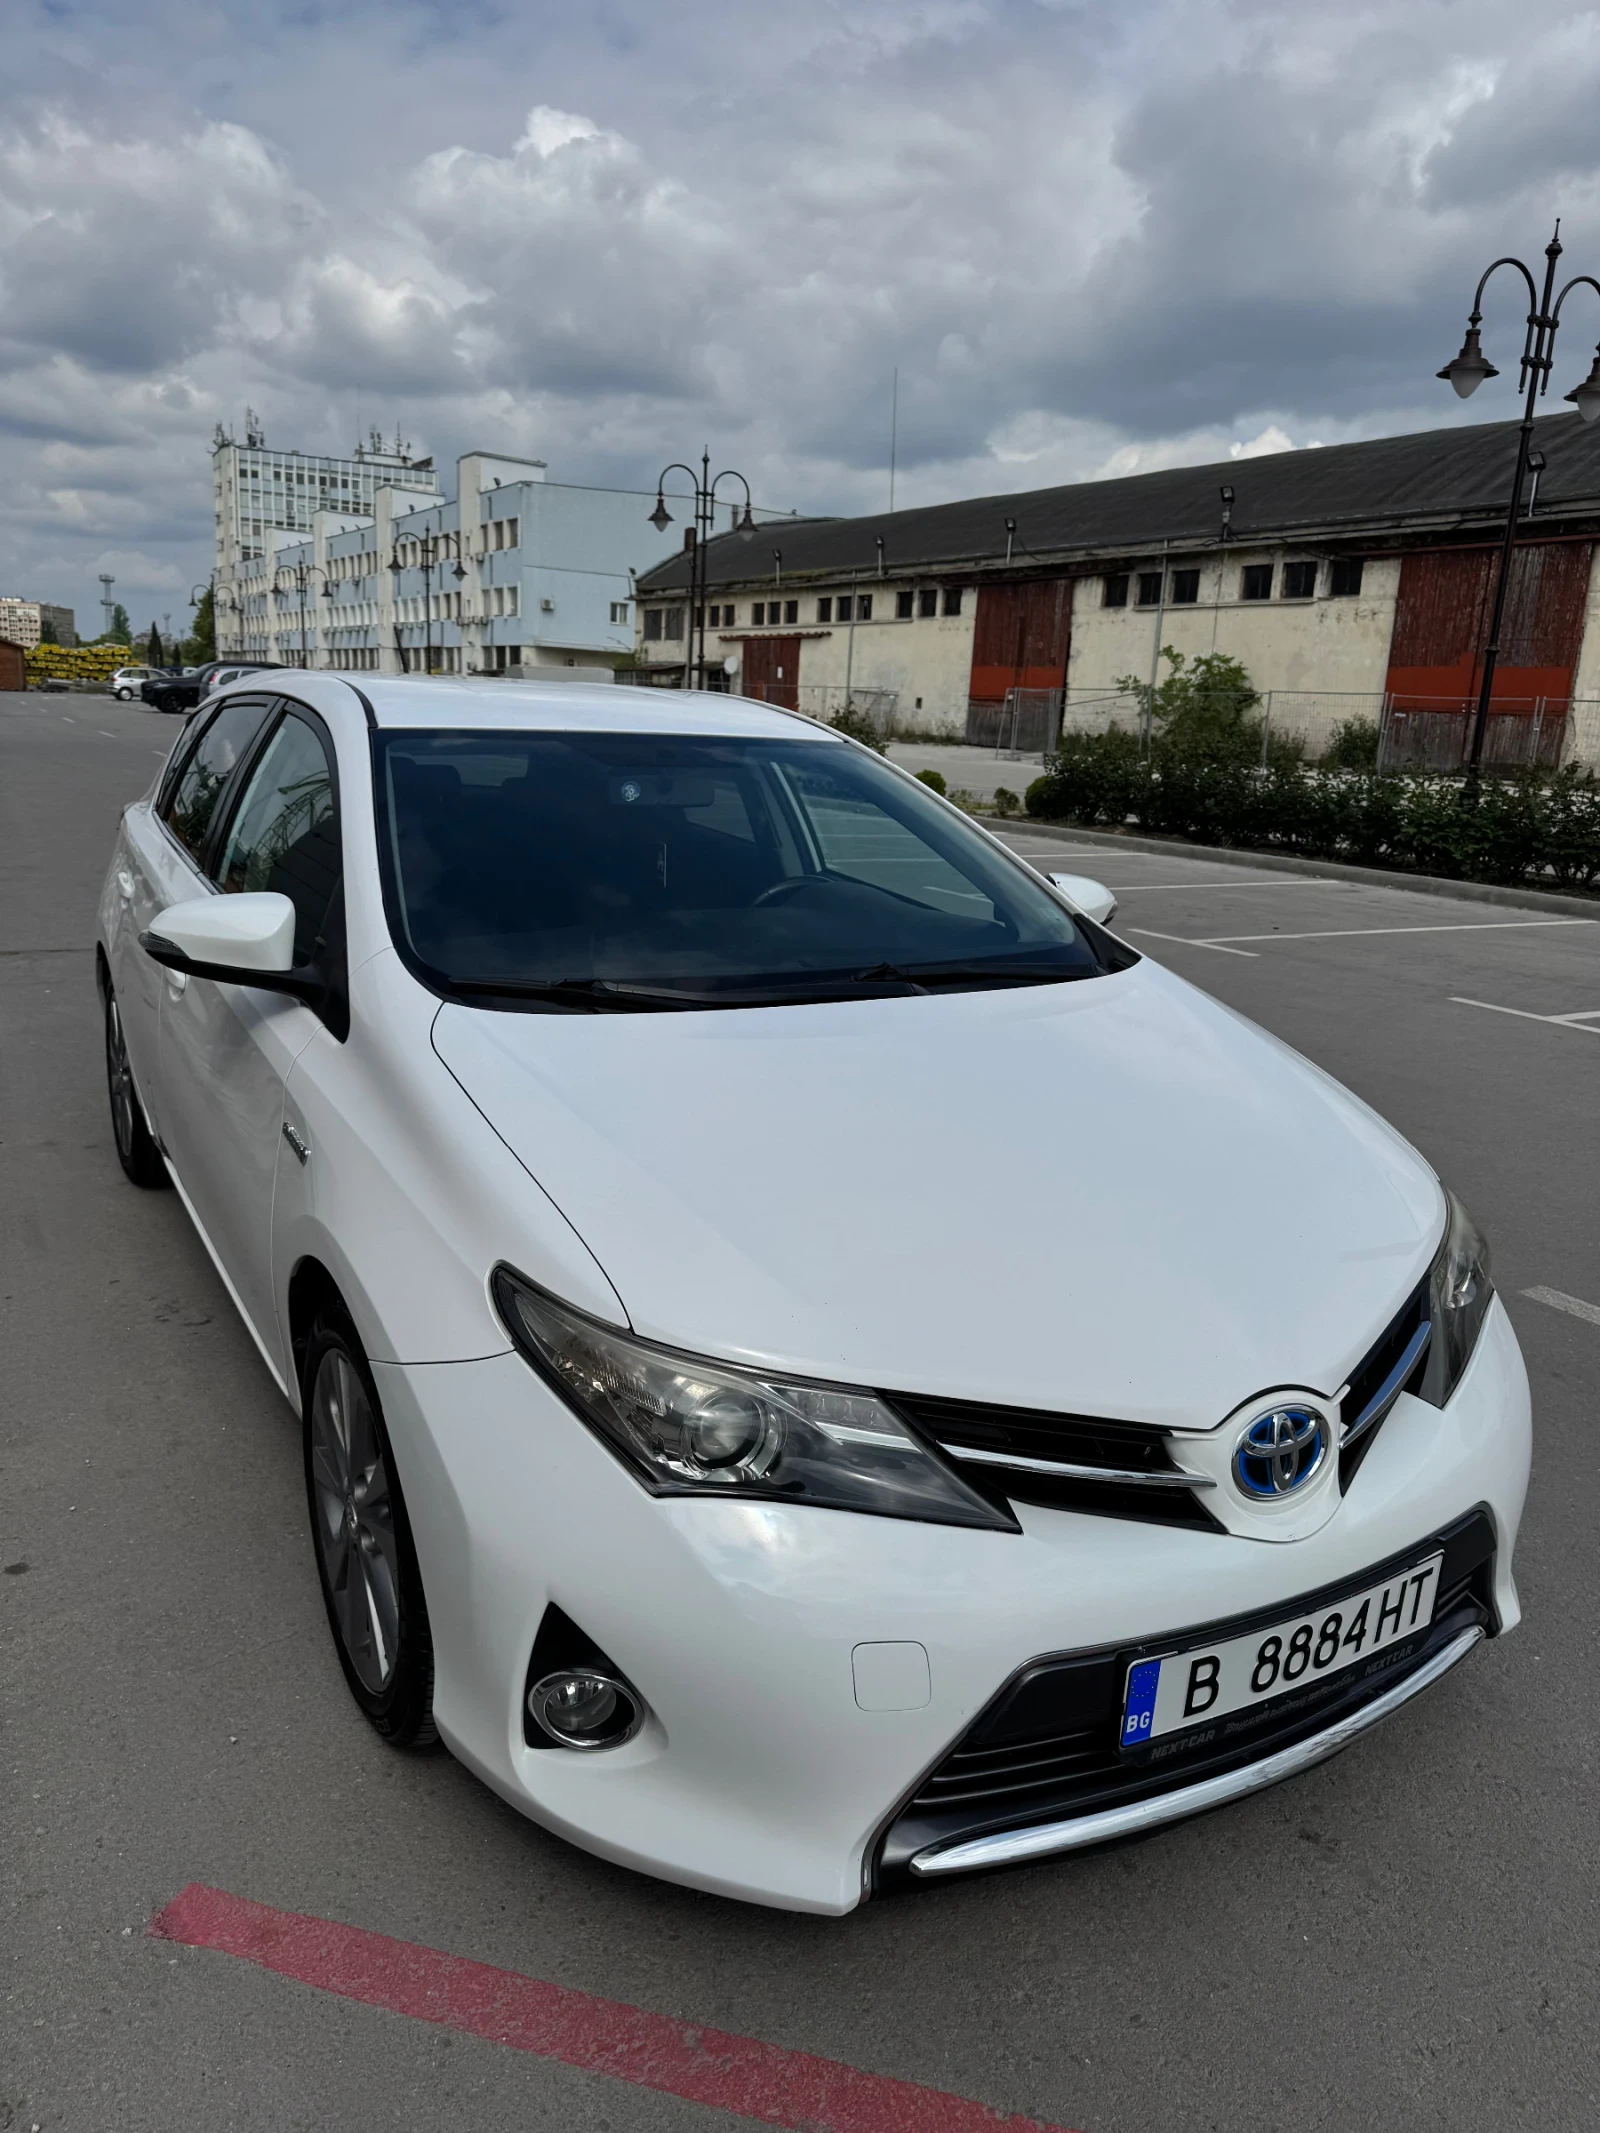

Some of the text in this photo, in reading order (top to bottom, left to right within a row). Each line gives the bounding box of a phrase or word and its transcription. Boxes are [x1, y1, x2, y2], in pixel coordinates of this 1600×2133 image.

[1364, 1644, 1414, 1676] NEXTCAR
[1182, 1655, 1220, 1718] B
[1126, 1711, 1150, 1733] BG
[1151, 1729, 1215, 1760] NEXTCAR
